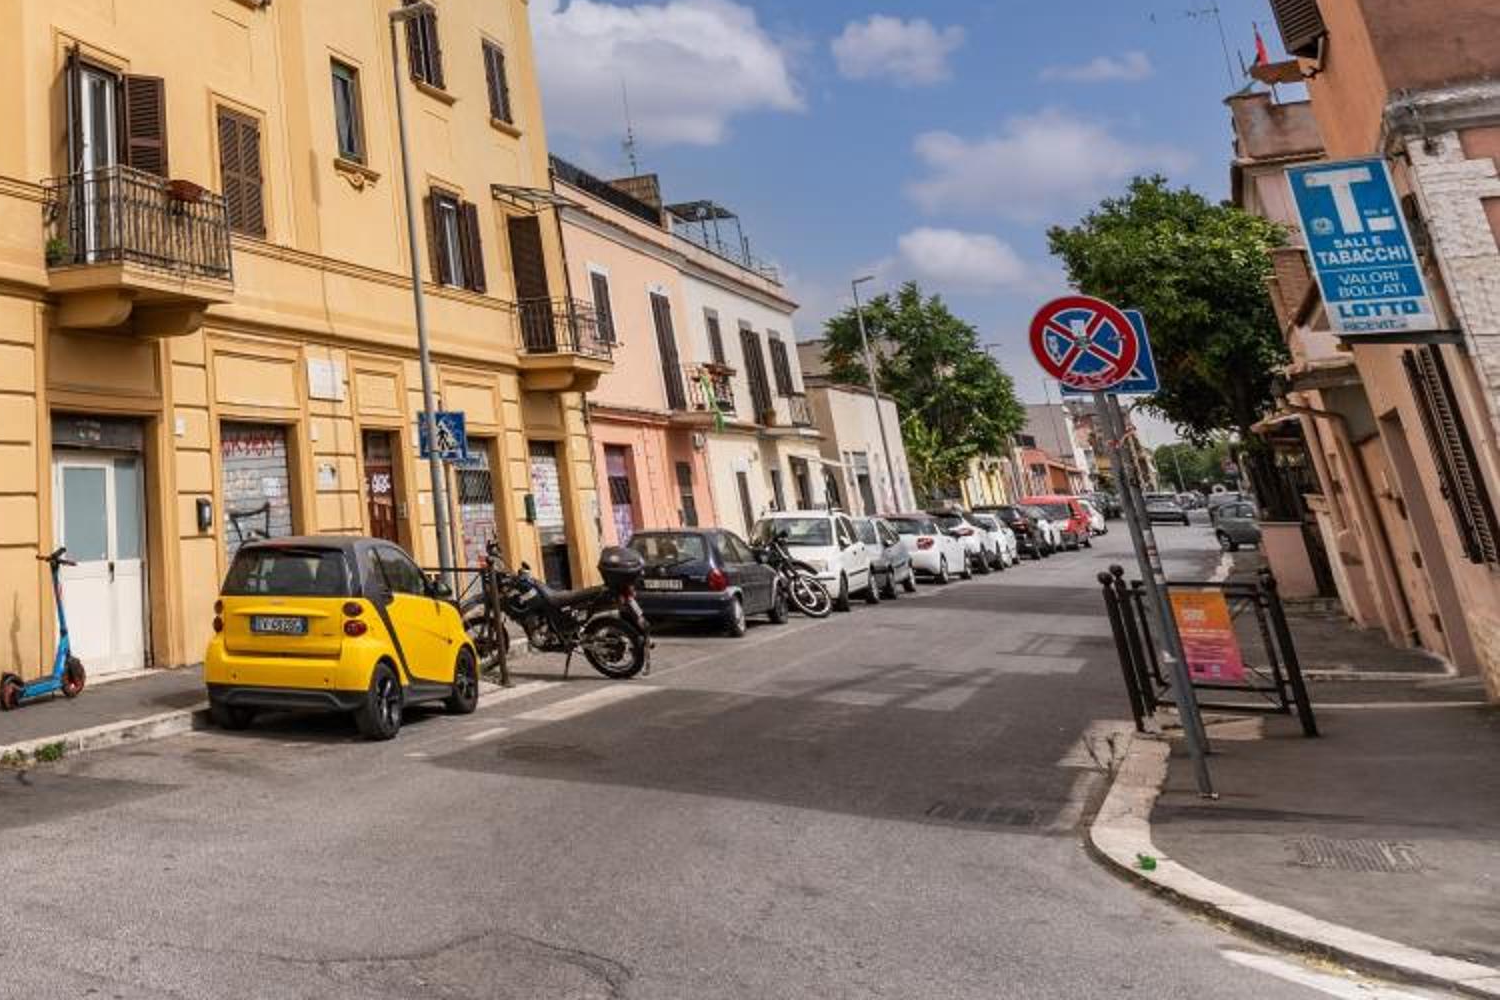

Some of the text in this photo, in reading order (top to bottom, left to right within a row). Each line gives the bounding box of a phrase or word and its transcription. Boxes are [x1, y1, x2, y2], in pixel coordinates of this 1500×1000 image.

[1333, 235, 1382, 249] SALI E
[1316, 245, 1409, 266] TABACCHI
[1338, 271, 1399, 285] VALORI
[1339, 284, 1407, 298] BOLLATI
[1338, 300, 1420, 318] LOTTO
